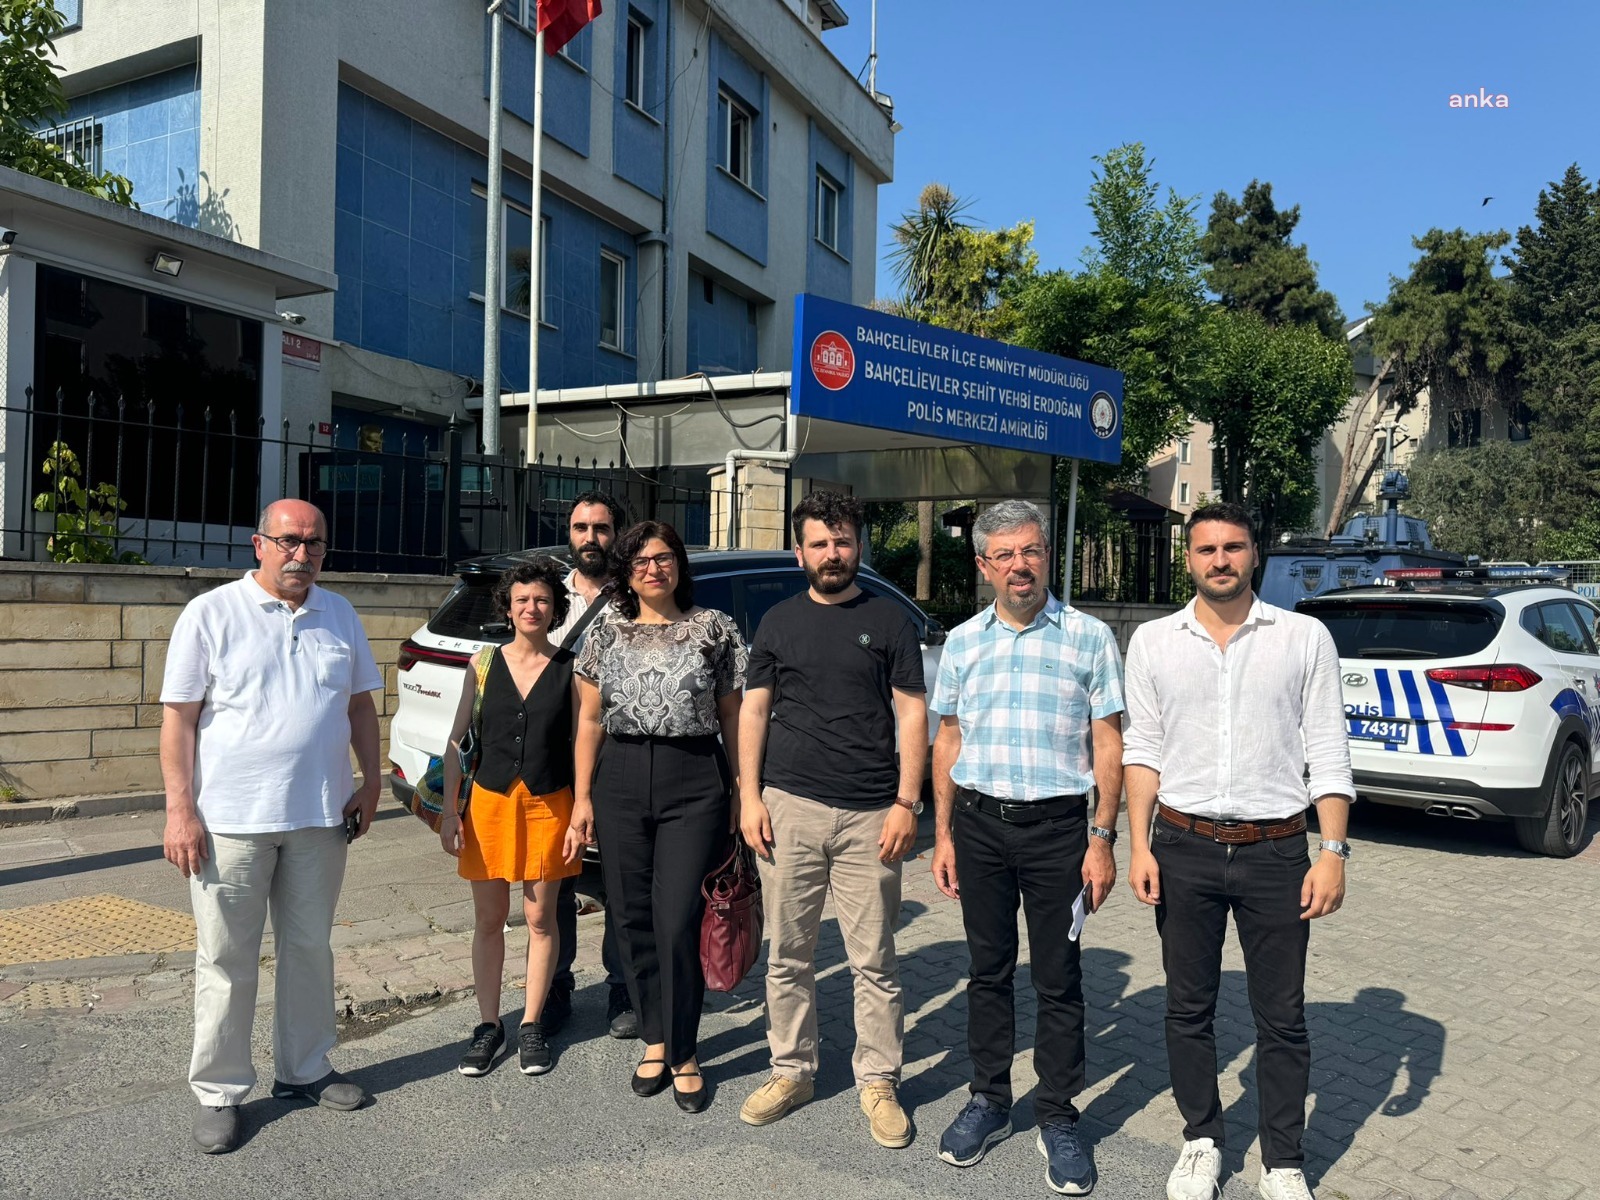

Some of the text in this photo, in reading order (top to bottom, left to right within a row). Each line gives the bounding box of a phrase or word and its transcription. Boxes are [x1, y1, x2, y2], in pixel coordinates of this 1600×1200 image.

[856, 326, 1090, 392] BAHÇELİEVLER İLÇE EMNİYET MÜDÜRLÜĞÜ
[864, 360, 1083, 420] BAHÇELİEVLER ŞEHİT VEHBİ ERDOĞAN
[906, 400, 1049, 441] POLİS MERKEZİ AMİRLİĞİ
[438, 640, 480, 651] CHE
[1360, 720, 1407, 738] 74311
